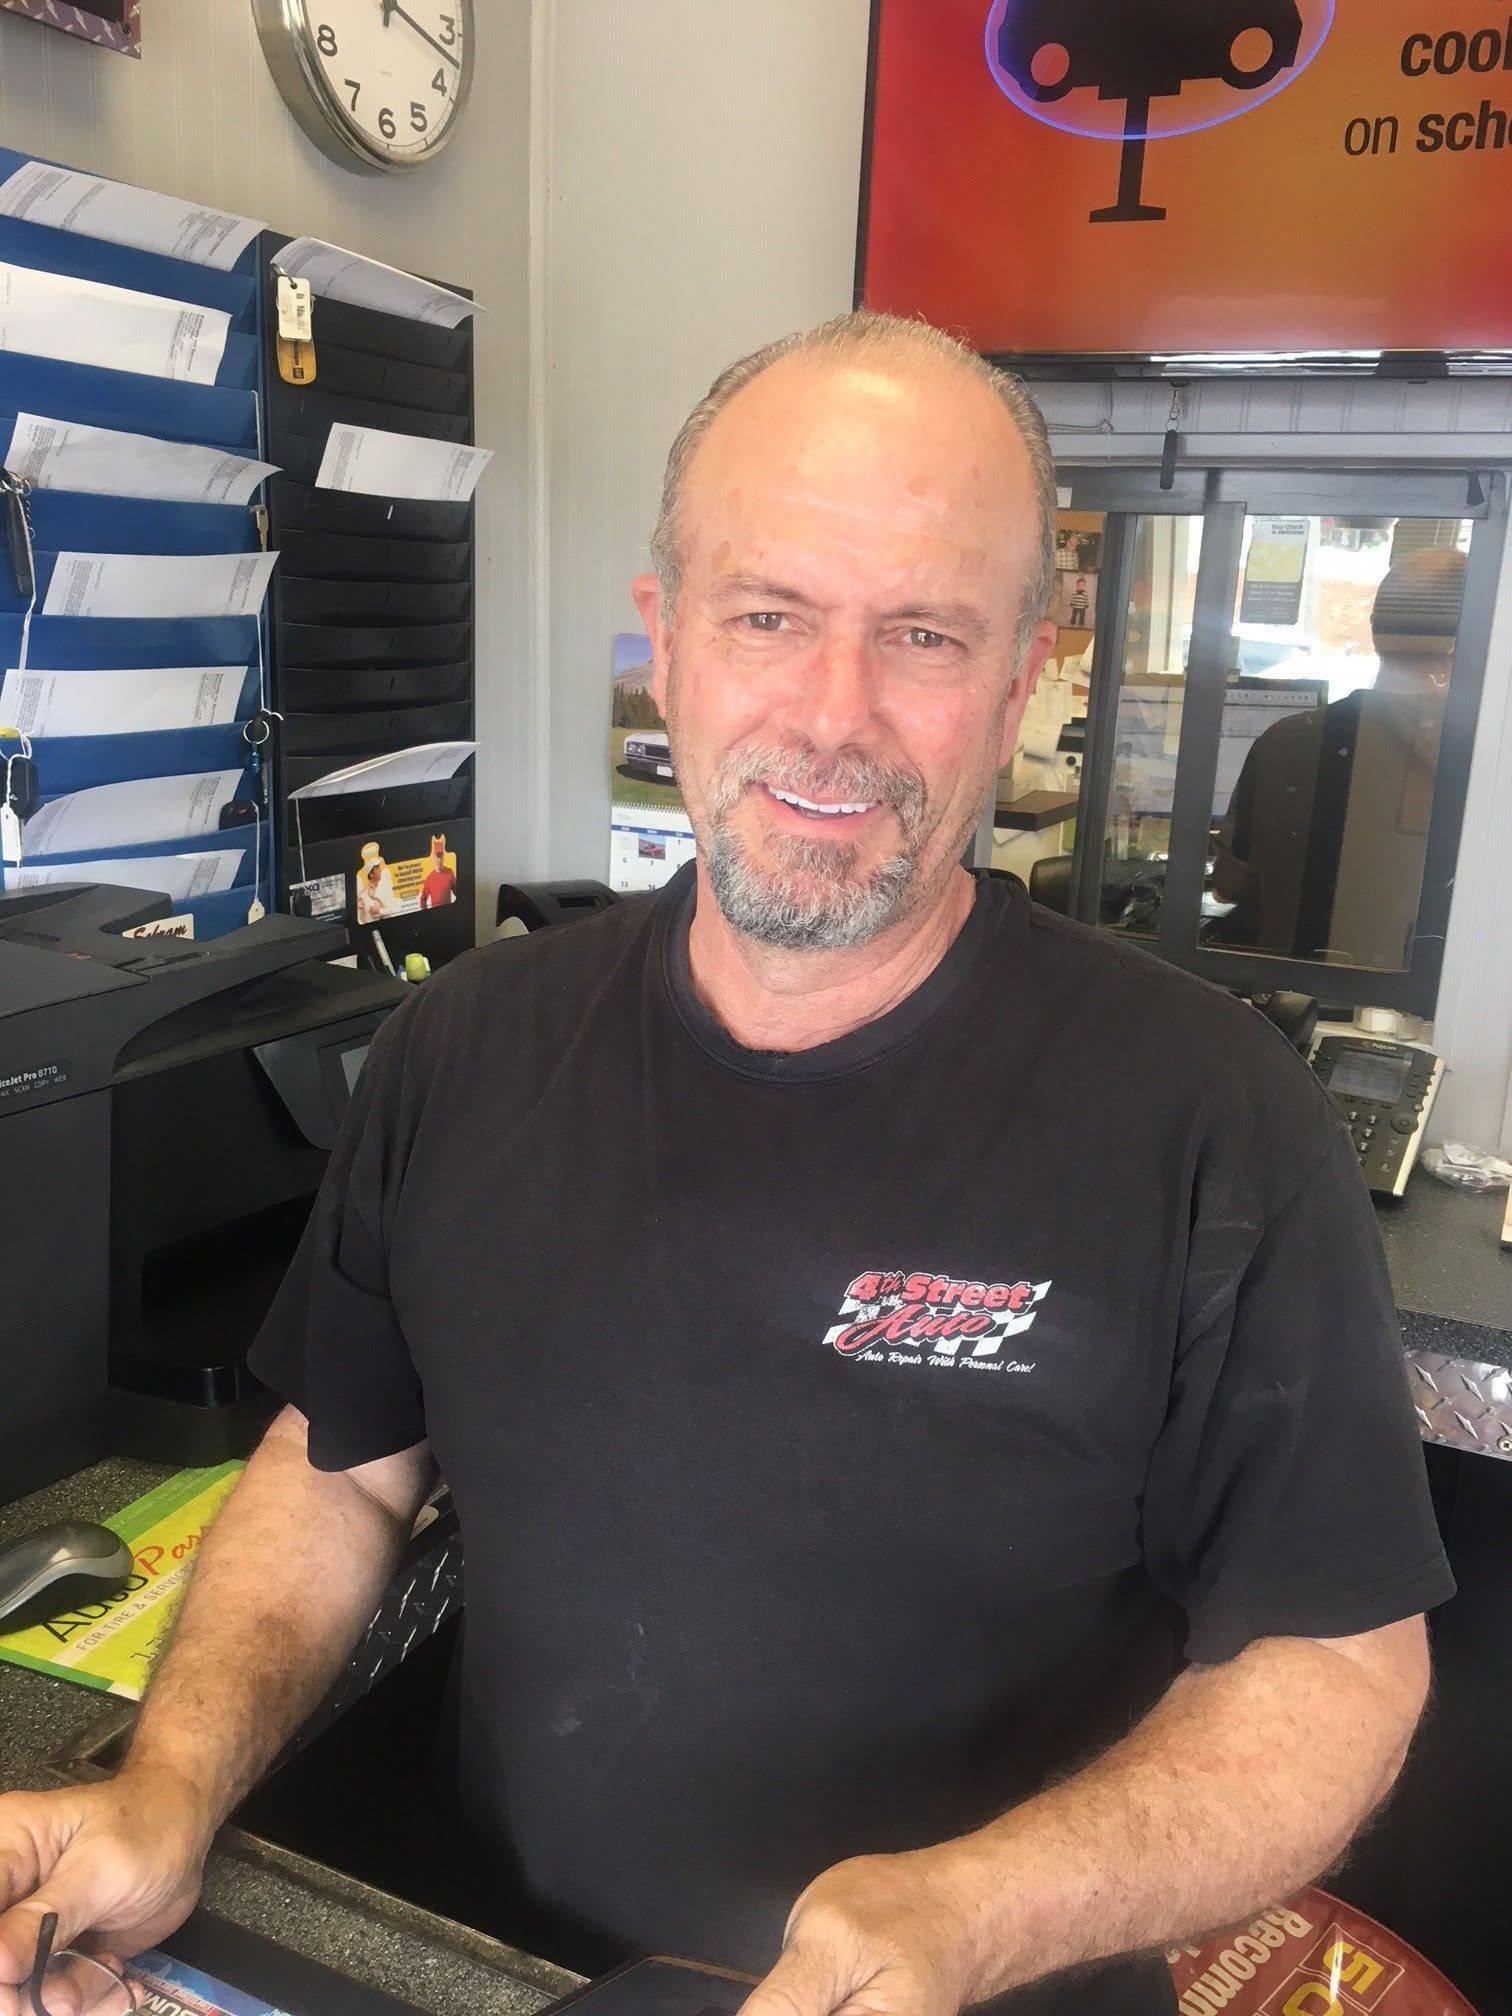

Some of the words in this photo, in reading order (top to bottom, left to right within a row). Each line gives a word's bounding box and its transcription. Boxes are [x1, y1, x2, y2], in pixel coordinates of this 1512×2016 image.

[317, 24, 338, 56] 8
[438, 14, 456, 46] 3
[344, 78, 360, 112] 7
[432, 68, 448, 98] 4
[378, 108, 396, 139] 6
[410, 101, 428, 132] 5
[1344, 116, 1399, 156] on
[1416, 100, 1512, 152] sch
[1372, 1042, 1397, 1051] Polycom
[13, 1084, 30, 1094] SCAN
[34, 1080, 50, 1088] COPY
[54, 1074, 67, 1083] WEB
[23, 1072, 37, 1081] Pro
[38, 1066, 58, 1077] 8710
[901, 1272, 1031, 1311] Street
[834, 1303, 997, 1355] Auto
[855, 1350, 885, 1362] Auto
[888, 1352, 922, 1364] Repair
[927, 1354, 956, 1368] With
[958, 1358, 1004, 1372] Personal
[1006, 1362, 1036, 1373] Care!
[75, 1632, 102, 1651] FOR
[103, 1610, 136, 1634] TIRE
[134, 1602, 147, 1612] &
